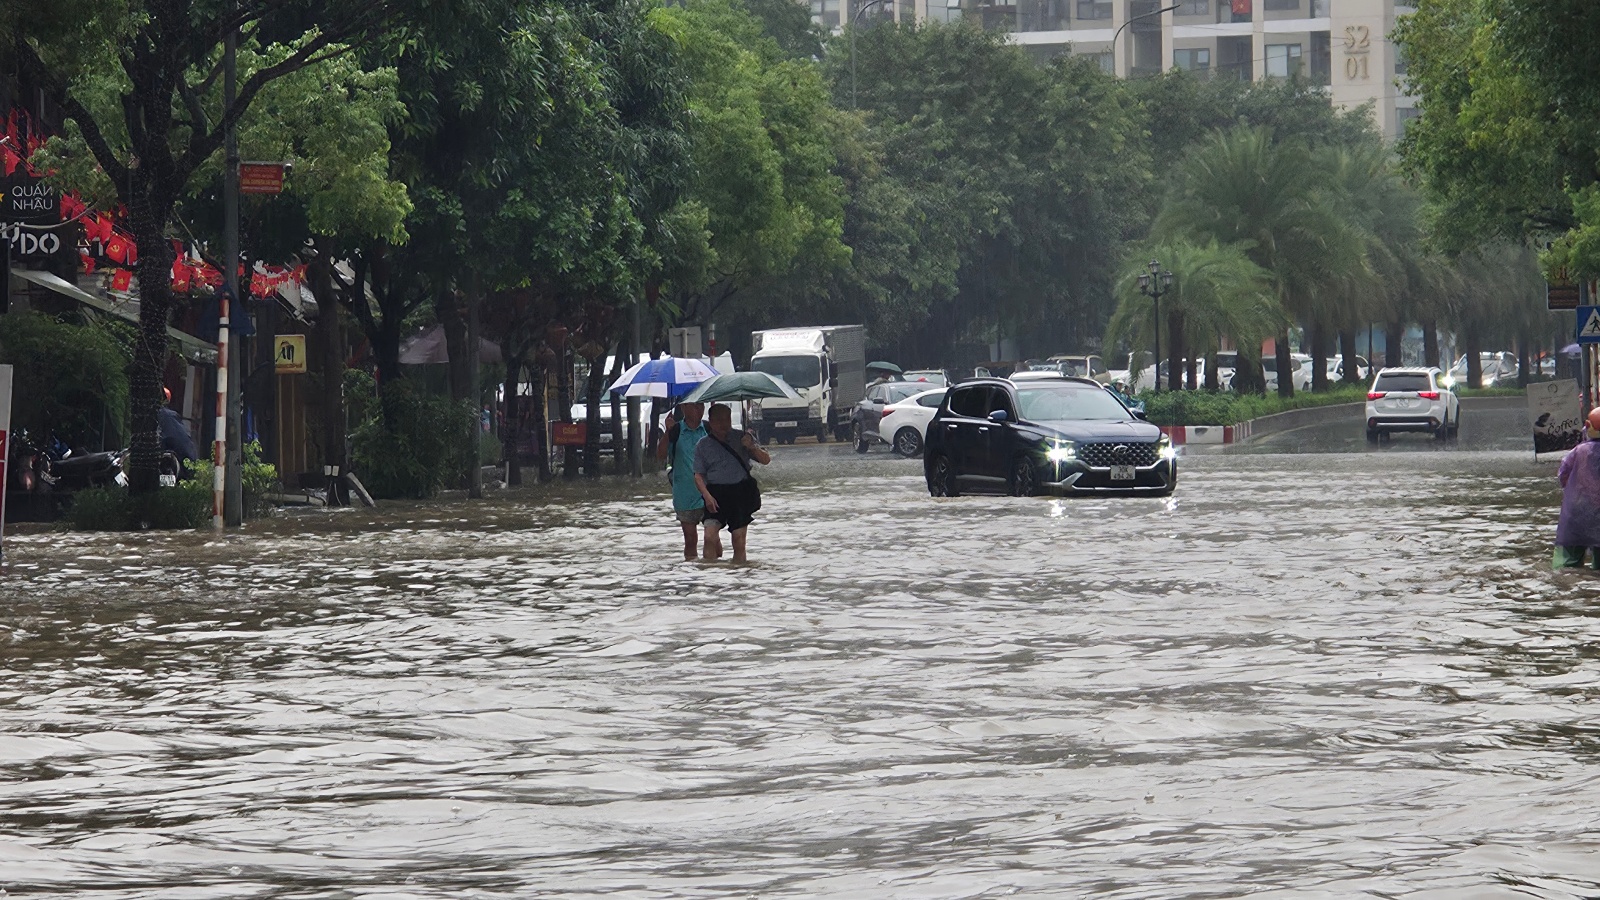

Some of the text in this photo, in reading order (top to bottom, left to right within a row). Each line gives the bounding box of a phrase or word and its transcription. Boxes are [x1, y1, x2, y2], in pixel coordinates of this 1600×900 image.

[1344, 25, 1370, 49] S2
[1345, 56, 1370, 80] 01
[13, 197, 53, 211] NHẬU
